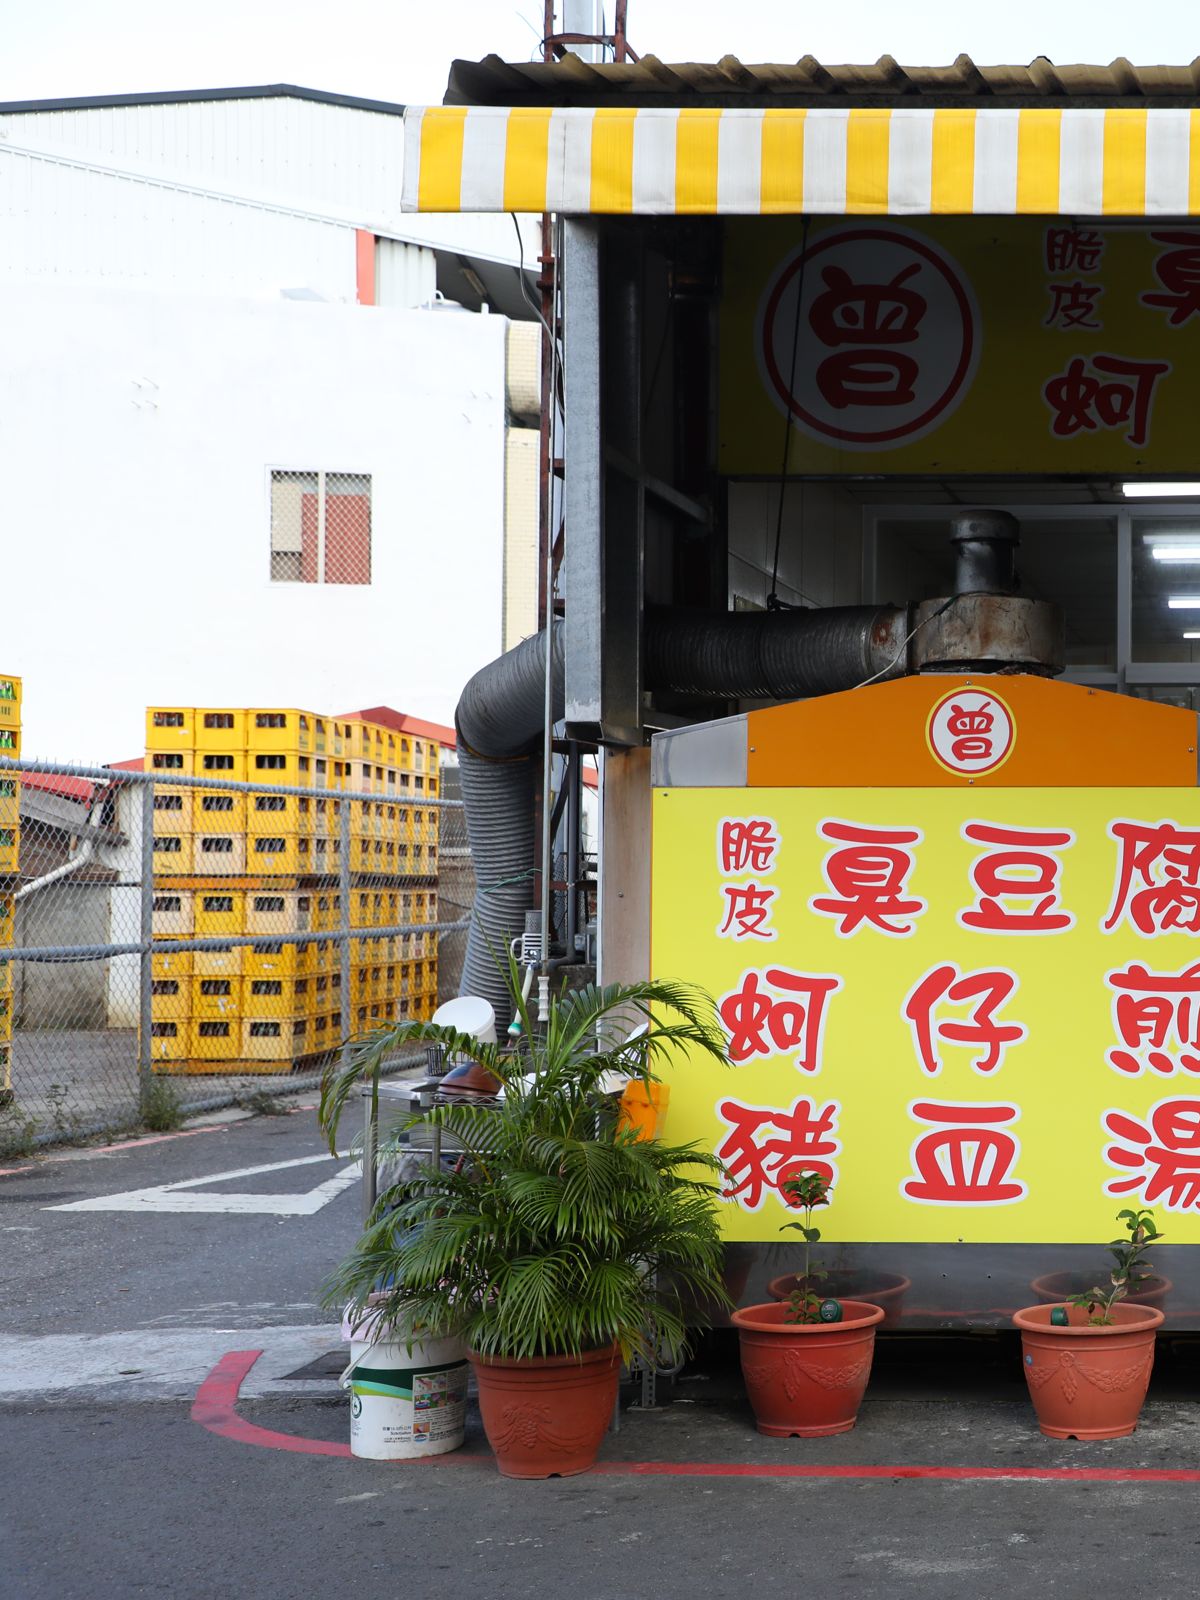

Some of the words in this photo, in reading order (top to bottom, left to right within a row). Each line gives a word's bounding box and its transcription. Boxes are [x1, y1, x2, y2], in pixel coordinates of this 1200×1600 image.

[1046, 229, 1103, 328] 脆皮
[808, 263, 927, 409] 曾
[947, 701, 995, 761] 曾
[721, 821, 778, 937] 脆皮
